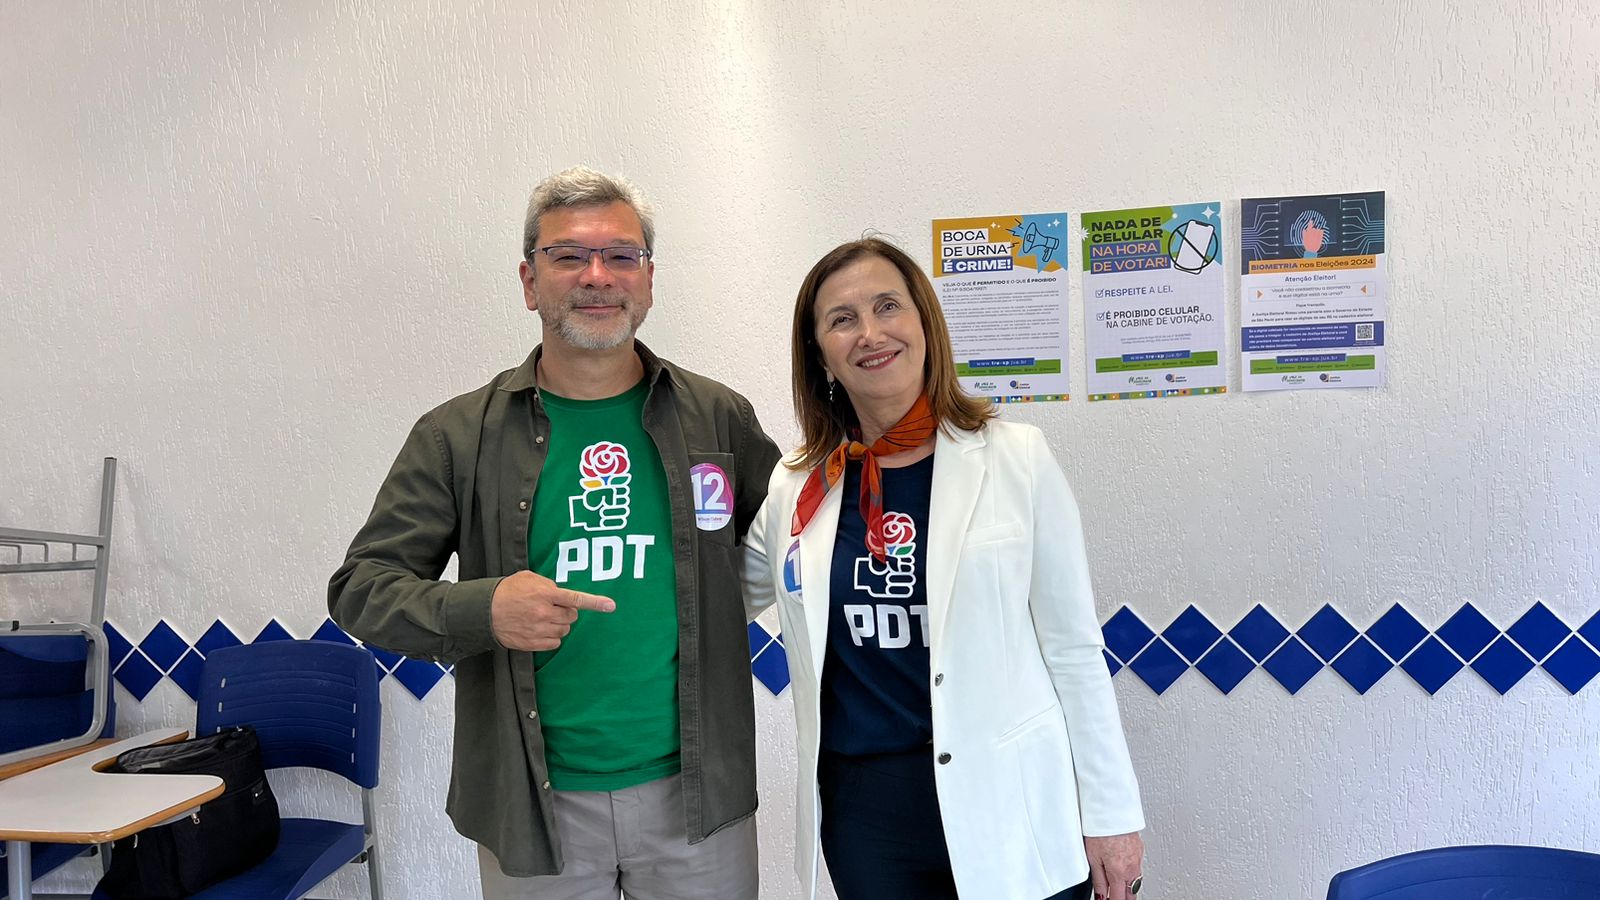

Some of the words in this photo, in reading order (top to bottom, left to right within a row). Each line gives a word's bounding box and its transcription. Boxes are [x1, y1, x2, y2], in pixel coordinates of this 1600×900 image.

[1091, 218, 1138, 232] NADA
[1140, 217, 1162, 228] DE
[943, 230, 986, 242] BOCA
[1092, 228, 1163, 242] CELULAR
[943, 246, 962, 257] DE
[966, 244, 1008, 256] URNA
[1092, 246, 1114, 257] NA
[1116, 242, 1158, 255] HORA
[944, 260, 953, 272] É
[956, 259, 1012, 271] CRIME!
[1093, 262, 1112, 272] DE
[1114, 257, 1168, 270] VOTAR!
[1250, 262, 1298, 271] BIOMETRIA
[1316, 260, 1349, 268] Eleições
[1104, 286, 1146, 298] RESPEITE
[1149, 286, 1156, 294] A
[1158, 285, 1174, 294] LEI.
[1105, 310, 1111, 320] É
[1114, 308, 1156, 319] PROIBIDO
[1158, 306, 1200, 316] CELULAR
[1106, 320, 1118, 328] NA
[1120, 318, 1154, 328] CABINE
[1156, 316, 1168, 325] DE
[1168, 313, 1214, 324] VOTAÇÃO.
[690, 472, 726, 510] 12
[555, 534, 656, 583] PDT
[844, 604, 930, 648] PDT
